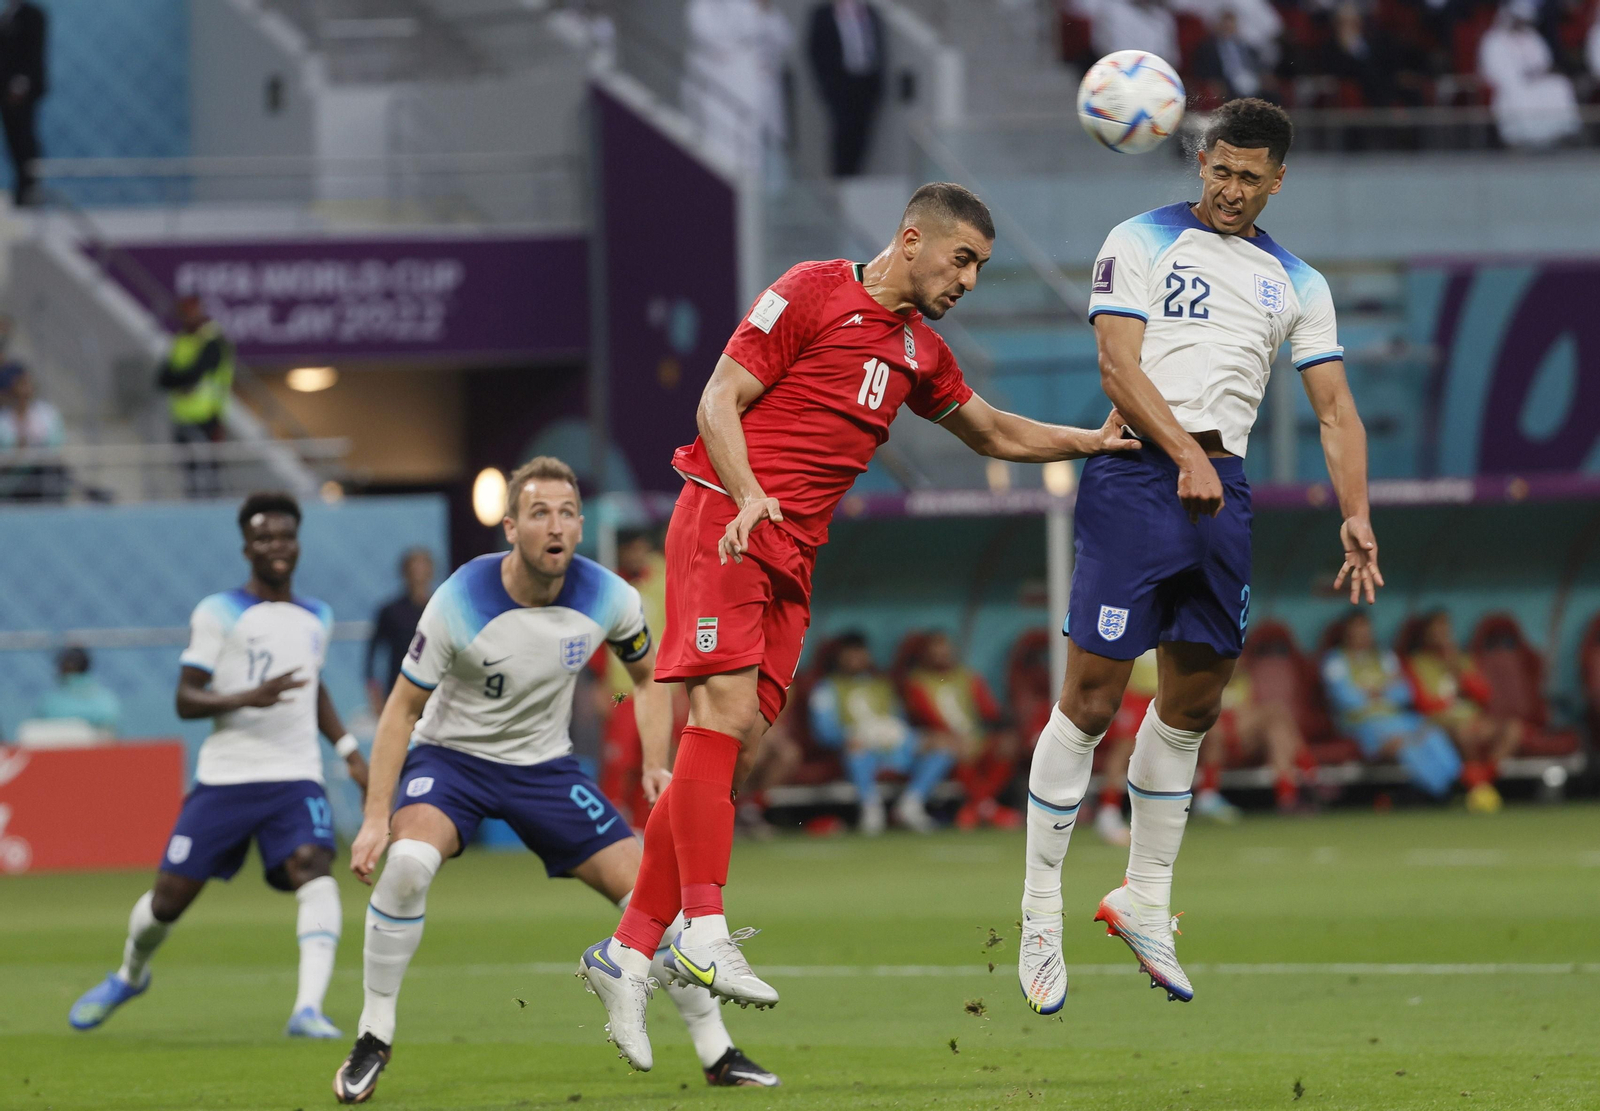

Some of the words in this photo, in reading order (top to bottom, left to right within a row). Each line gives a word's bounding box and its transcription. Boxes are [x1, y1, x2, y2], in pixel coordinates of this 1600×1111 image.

[260, 260, 388, 297] WORLD
[391, 258, 465, 293] CUP
[1163, 271, 1211, 320] 22
[857, 357, 890, 410] 19
[484, 672, 505, 699] 9
[569, 784, 605, 821] 9
